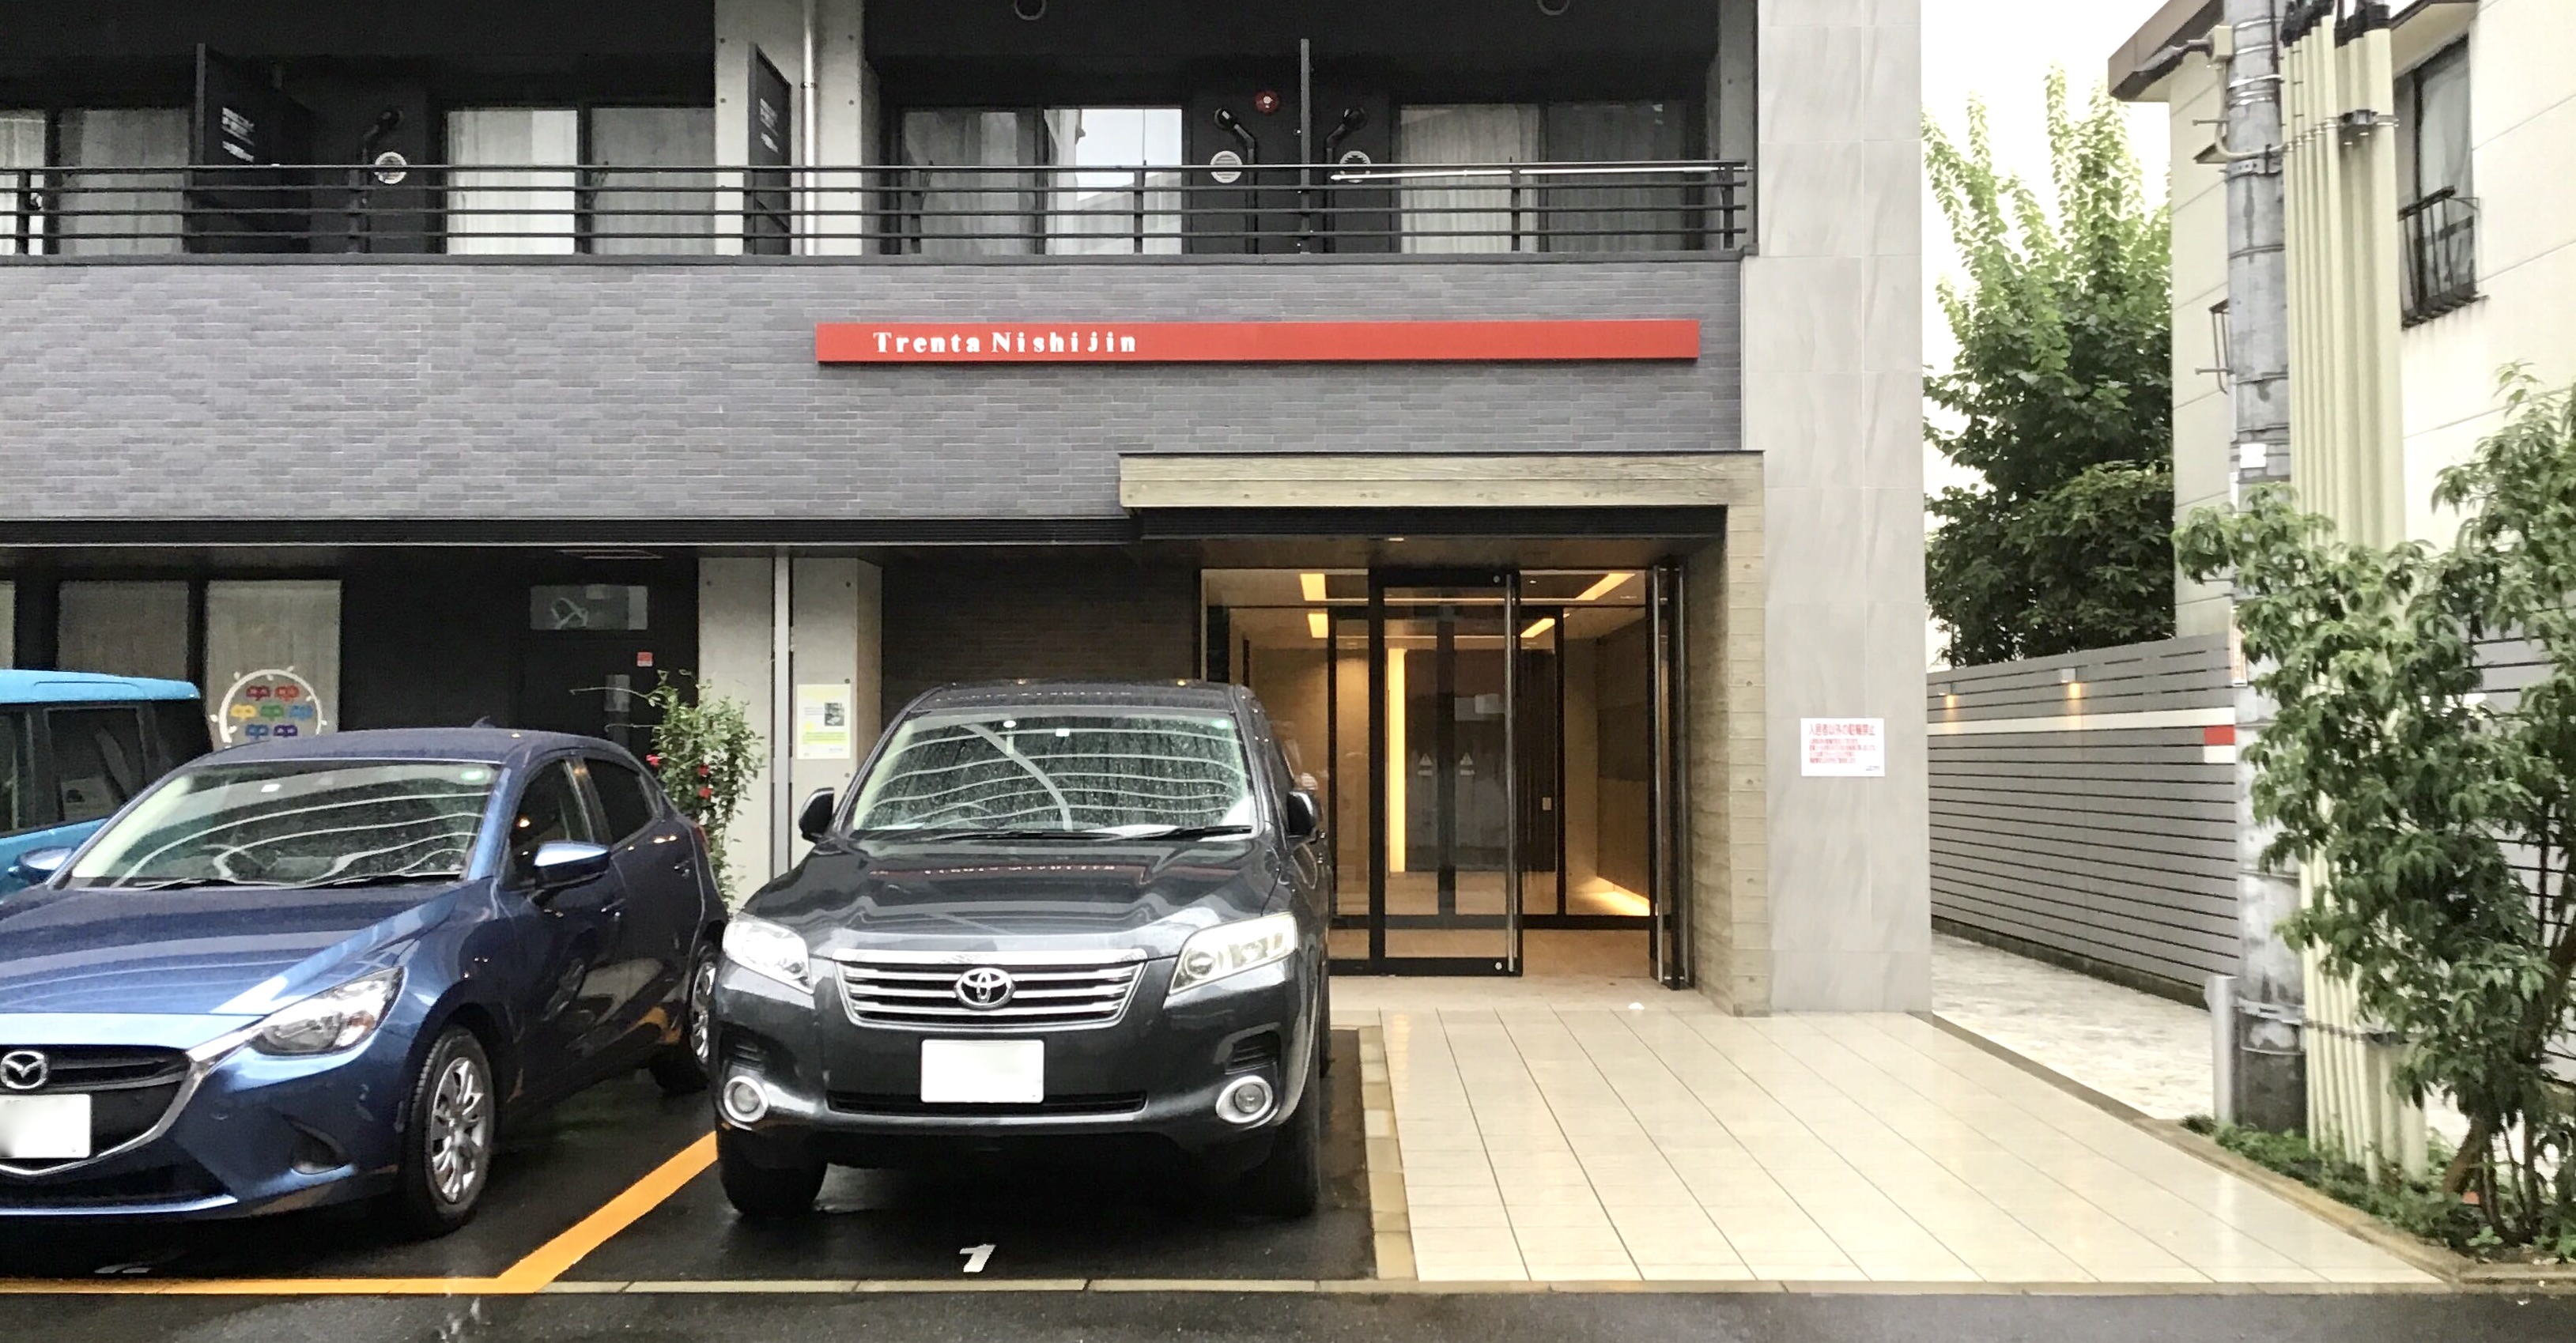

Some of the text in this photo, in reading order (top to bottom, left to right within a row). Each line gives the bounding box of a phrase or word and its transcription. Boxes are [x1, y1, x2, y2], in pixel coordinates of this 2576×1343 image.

[872, 330, 1136, 353] Trenta Nishijin
[959, 1243, 996, 1273] 1
